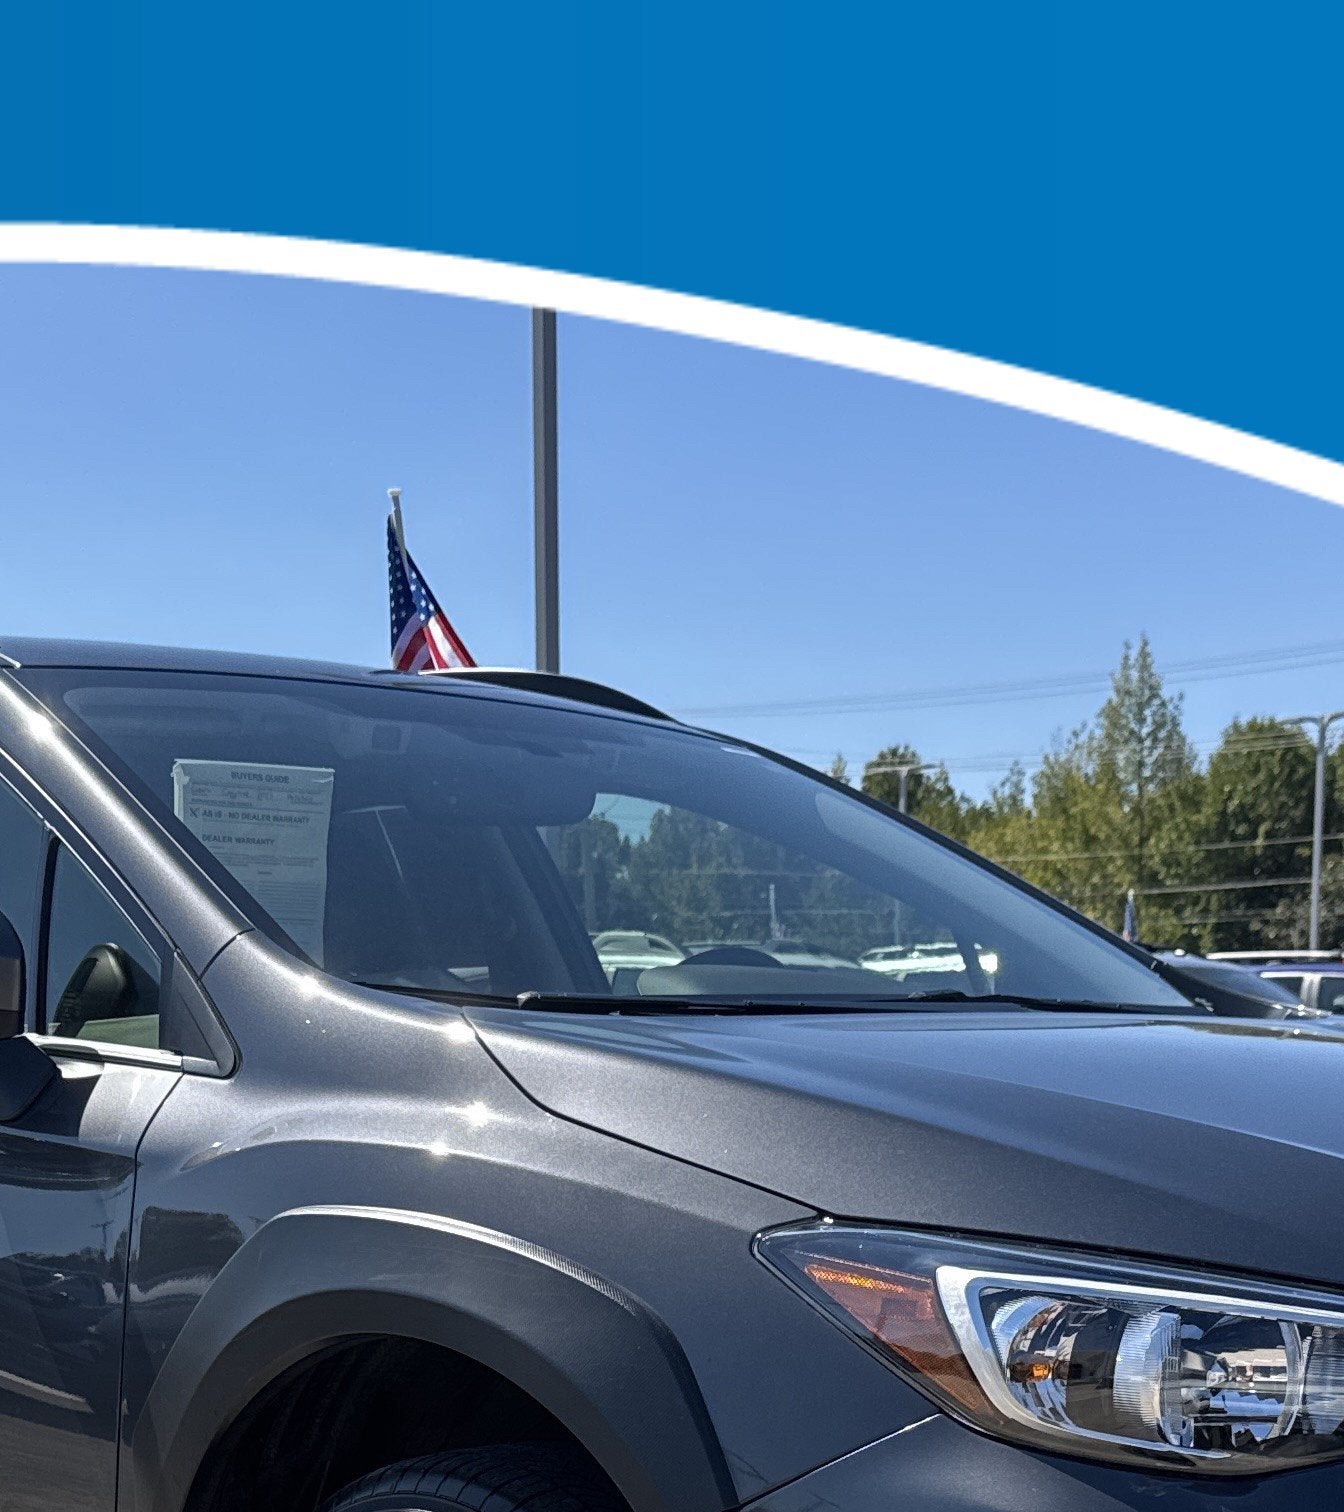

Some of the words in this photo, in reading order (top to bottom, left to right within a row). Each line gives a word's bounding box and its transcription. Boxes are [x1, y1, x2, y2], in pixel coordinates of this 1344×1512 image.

[230, 772, 263, 782] BUYERS
[265, 774, 290, 784] GUIDE
[229, 811, 239, 820] NO
[241, 812, 271, 822] DEALER
[272, 815, 310, 825] WARRANTY
[202, 834, 233, 843] DEALER
[235, 836, 275, 846] WARRANTY
